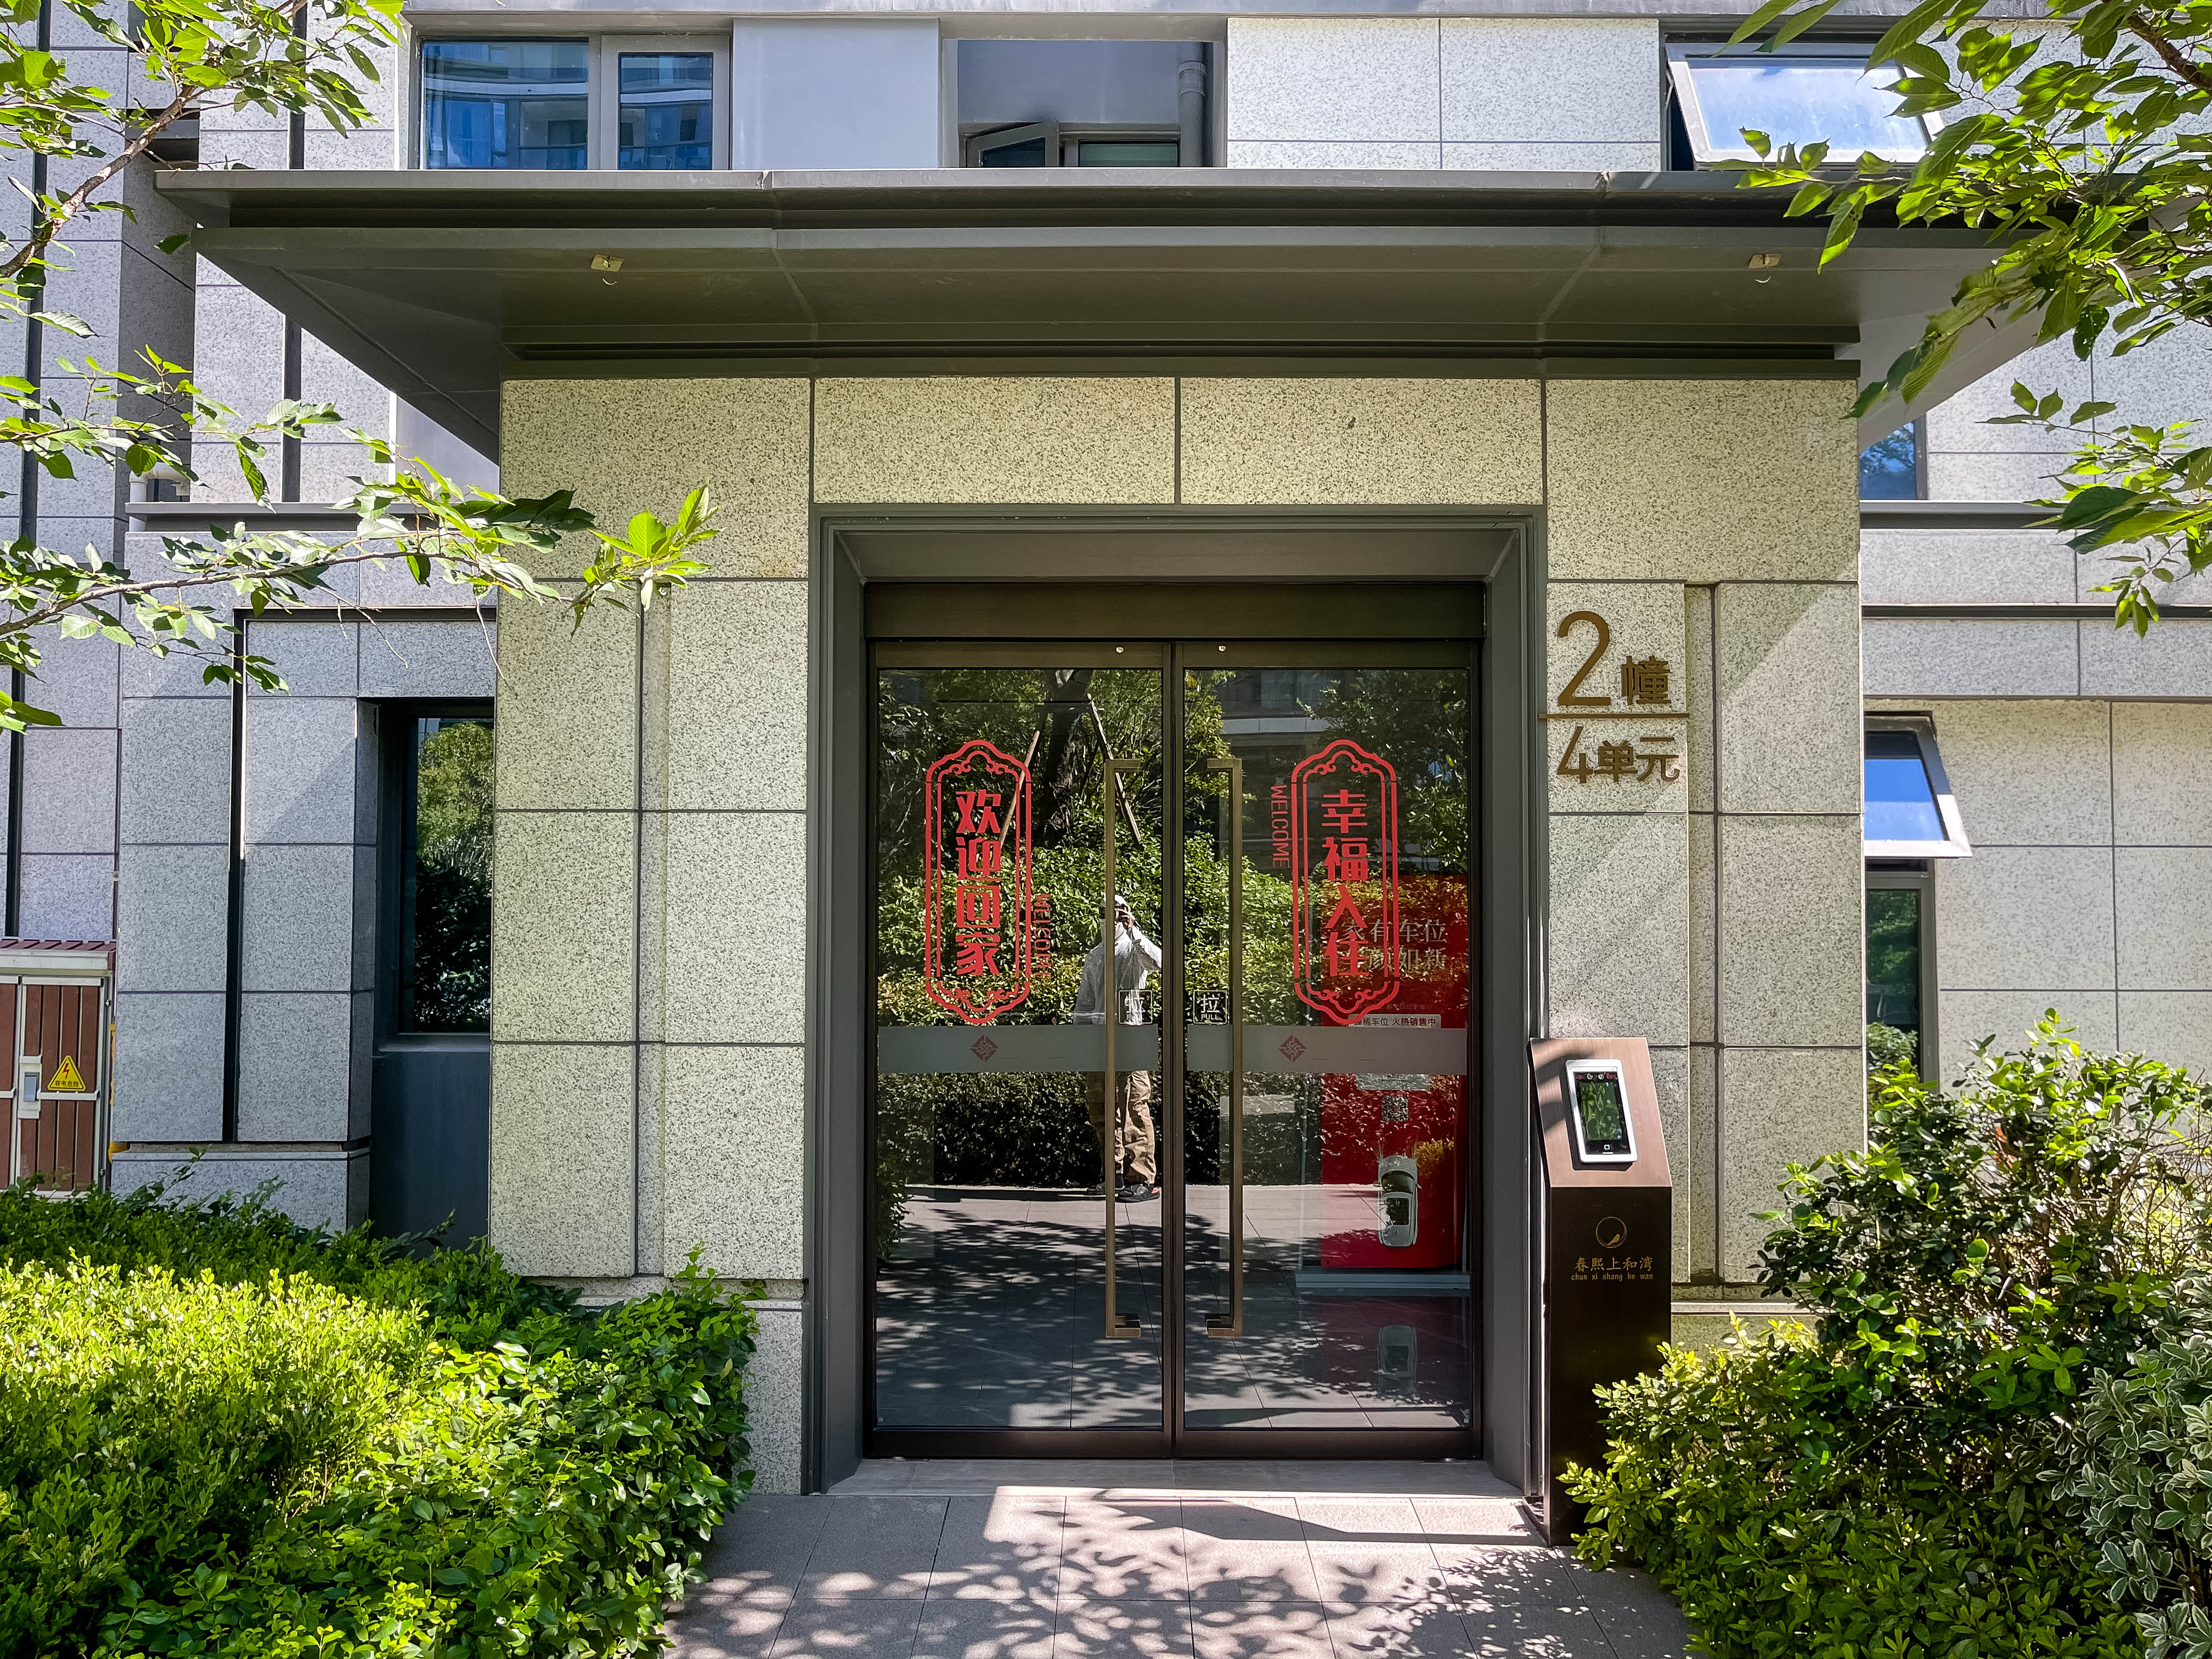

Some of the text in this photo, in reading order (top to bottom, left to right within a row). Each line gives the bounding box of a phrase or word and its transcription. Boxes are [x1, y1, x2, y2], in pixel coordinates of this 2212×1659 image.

[1558, 611, 1672, 706] 2幢
[1558, 726, 1680, 783] 4单元
[1271, 785, 1291, 868] WELCOME
[956, 789, 1001, 975] 欢迎回家
[1321, 789, 1369, 977] 幸福入住
[1034, 894, 1051, 982] WELCOME
[1341, 947, 1447, 970] 颜如新
[1201, 994, 1220, 1013] 拉
[1392, 1017, 1436, 1026] 火热销售中
[1571, 1272, 1587, 1280] chun
[1592, 1272, 1598, 1280] xi
[1602, 1272, 1622, 1282] shang
[1574, 1256, 1652, 1272] 春熙上和湾
